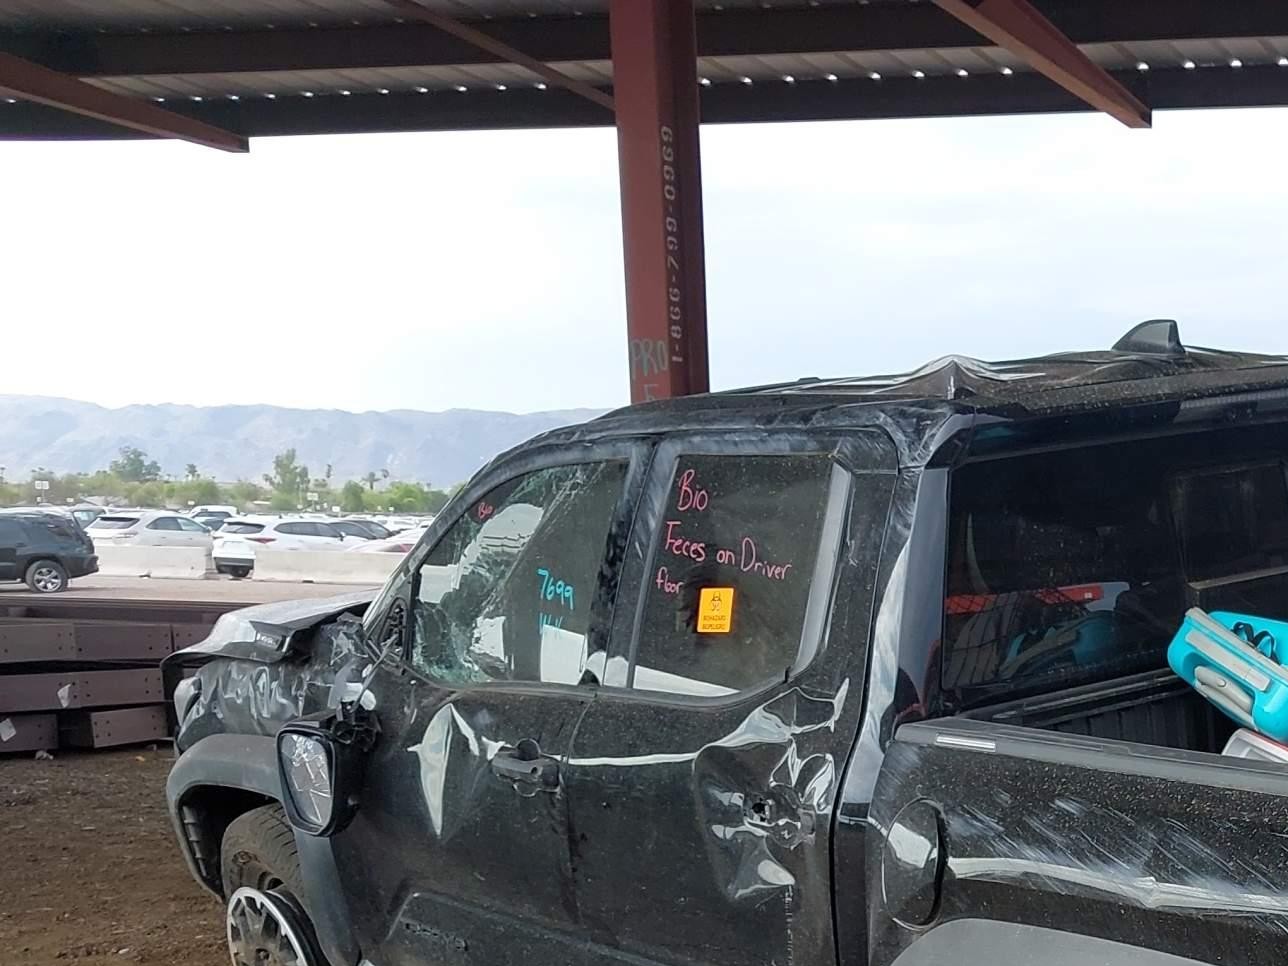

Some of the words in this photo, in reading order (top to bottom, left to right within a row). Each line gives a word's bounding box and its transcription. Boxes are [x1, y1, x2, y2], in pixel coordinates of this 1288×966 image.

[631, 338, 669, 380] PRO
[677, 469, 708, 511] Bio
[665, 521, 706, 562] Feces
[716, 550, 735, 565] on
[740, 537, 793, 580] Driver
[536, 568, 574, 610] 7699
